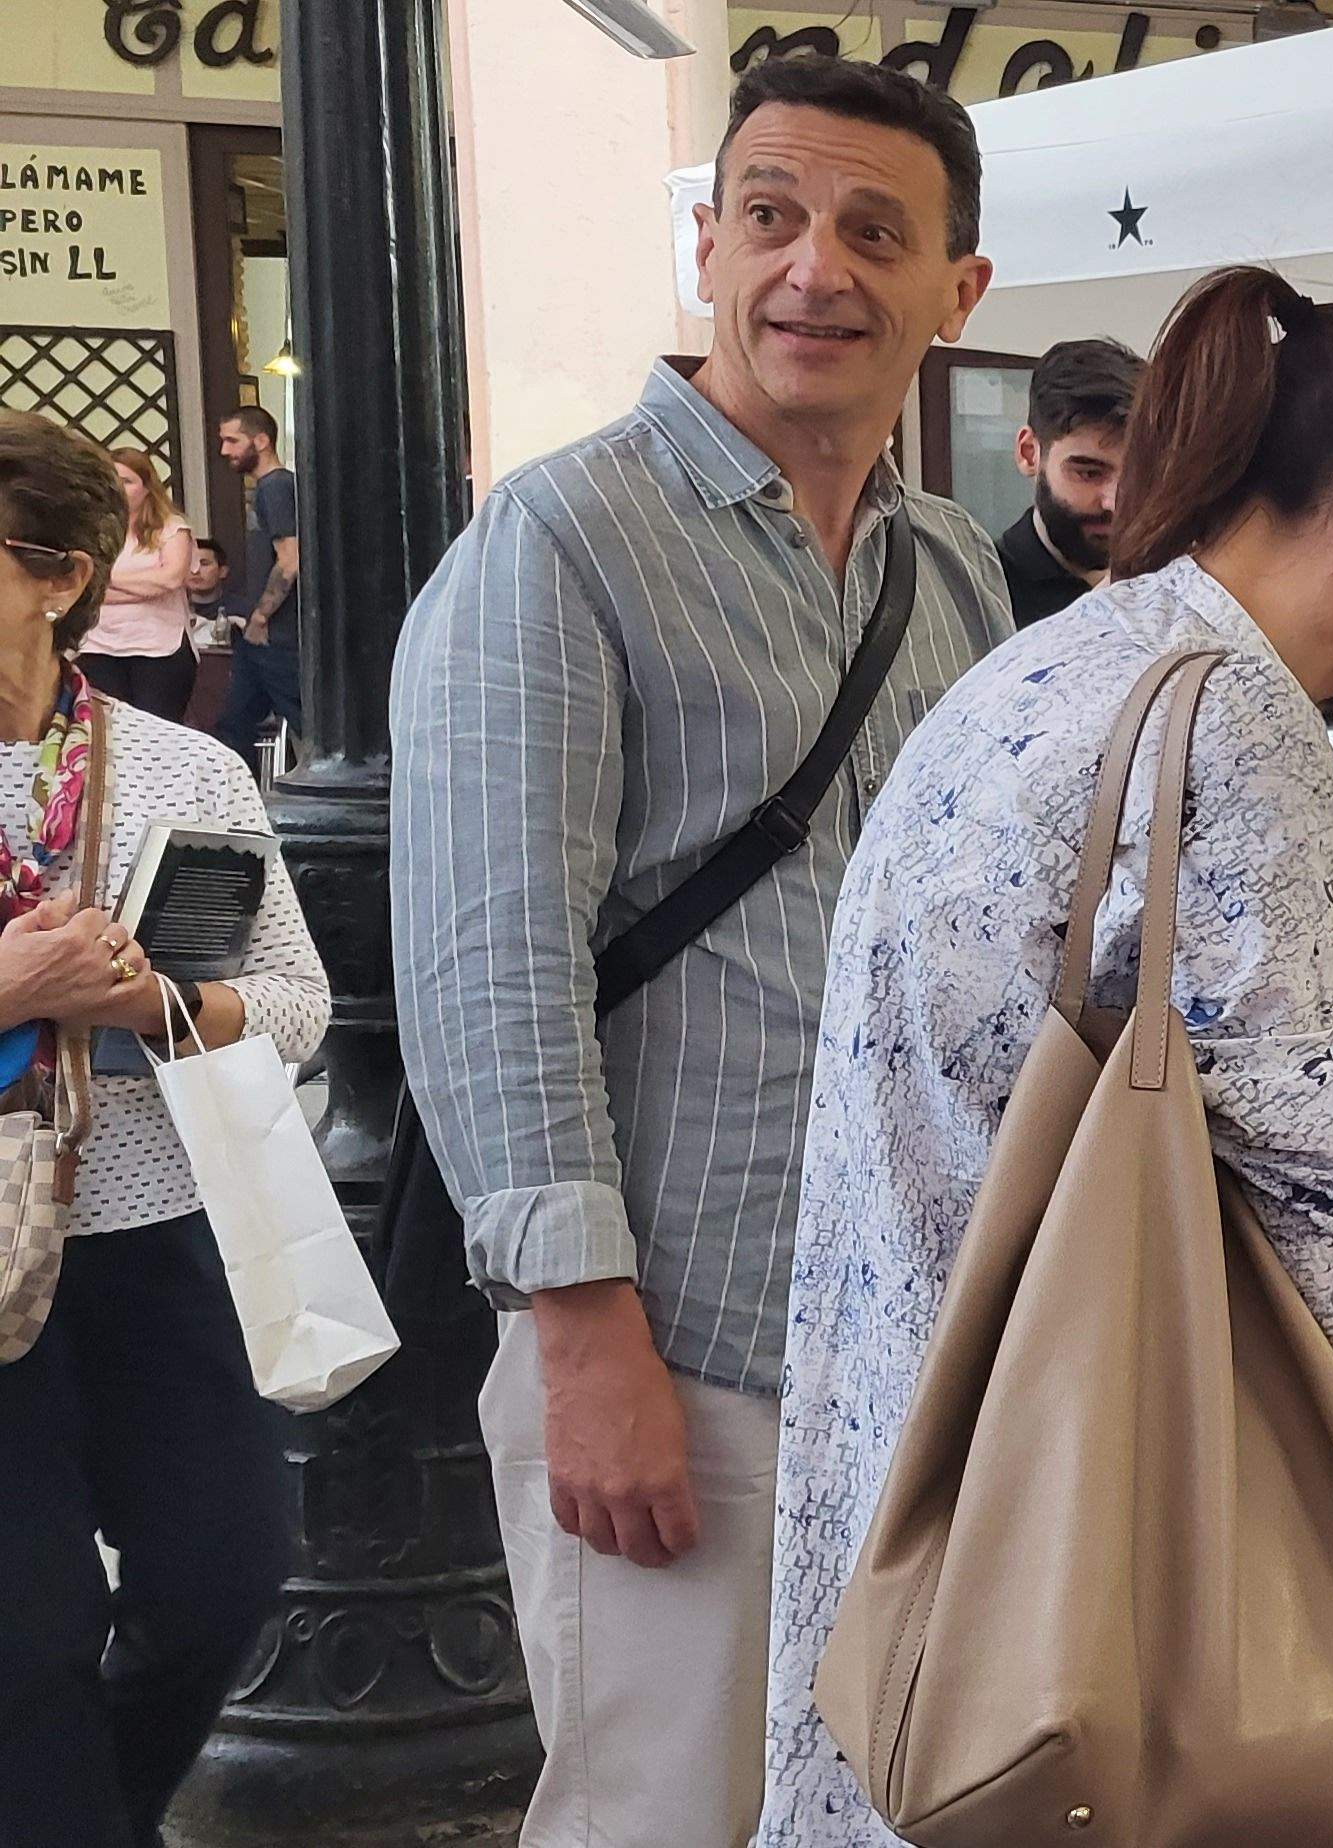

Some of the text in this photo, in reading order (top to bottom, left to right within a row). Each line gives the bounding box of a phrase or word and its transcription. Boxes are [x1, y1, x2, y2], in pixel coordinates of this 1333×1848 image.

[1, 154, 147, 195] LÁMAME
[0, 209, 83, 233] PERO
[0, 245, 117, 280] SIN LL
